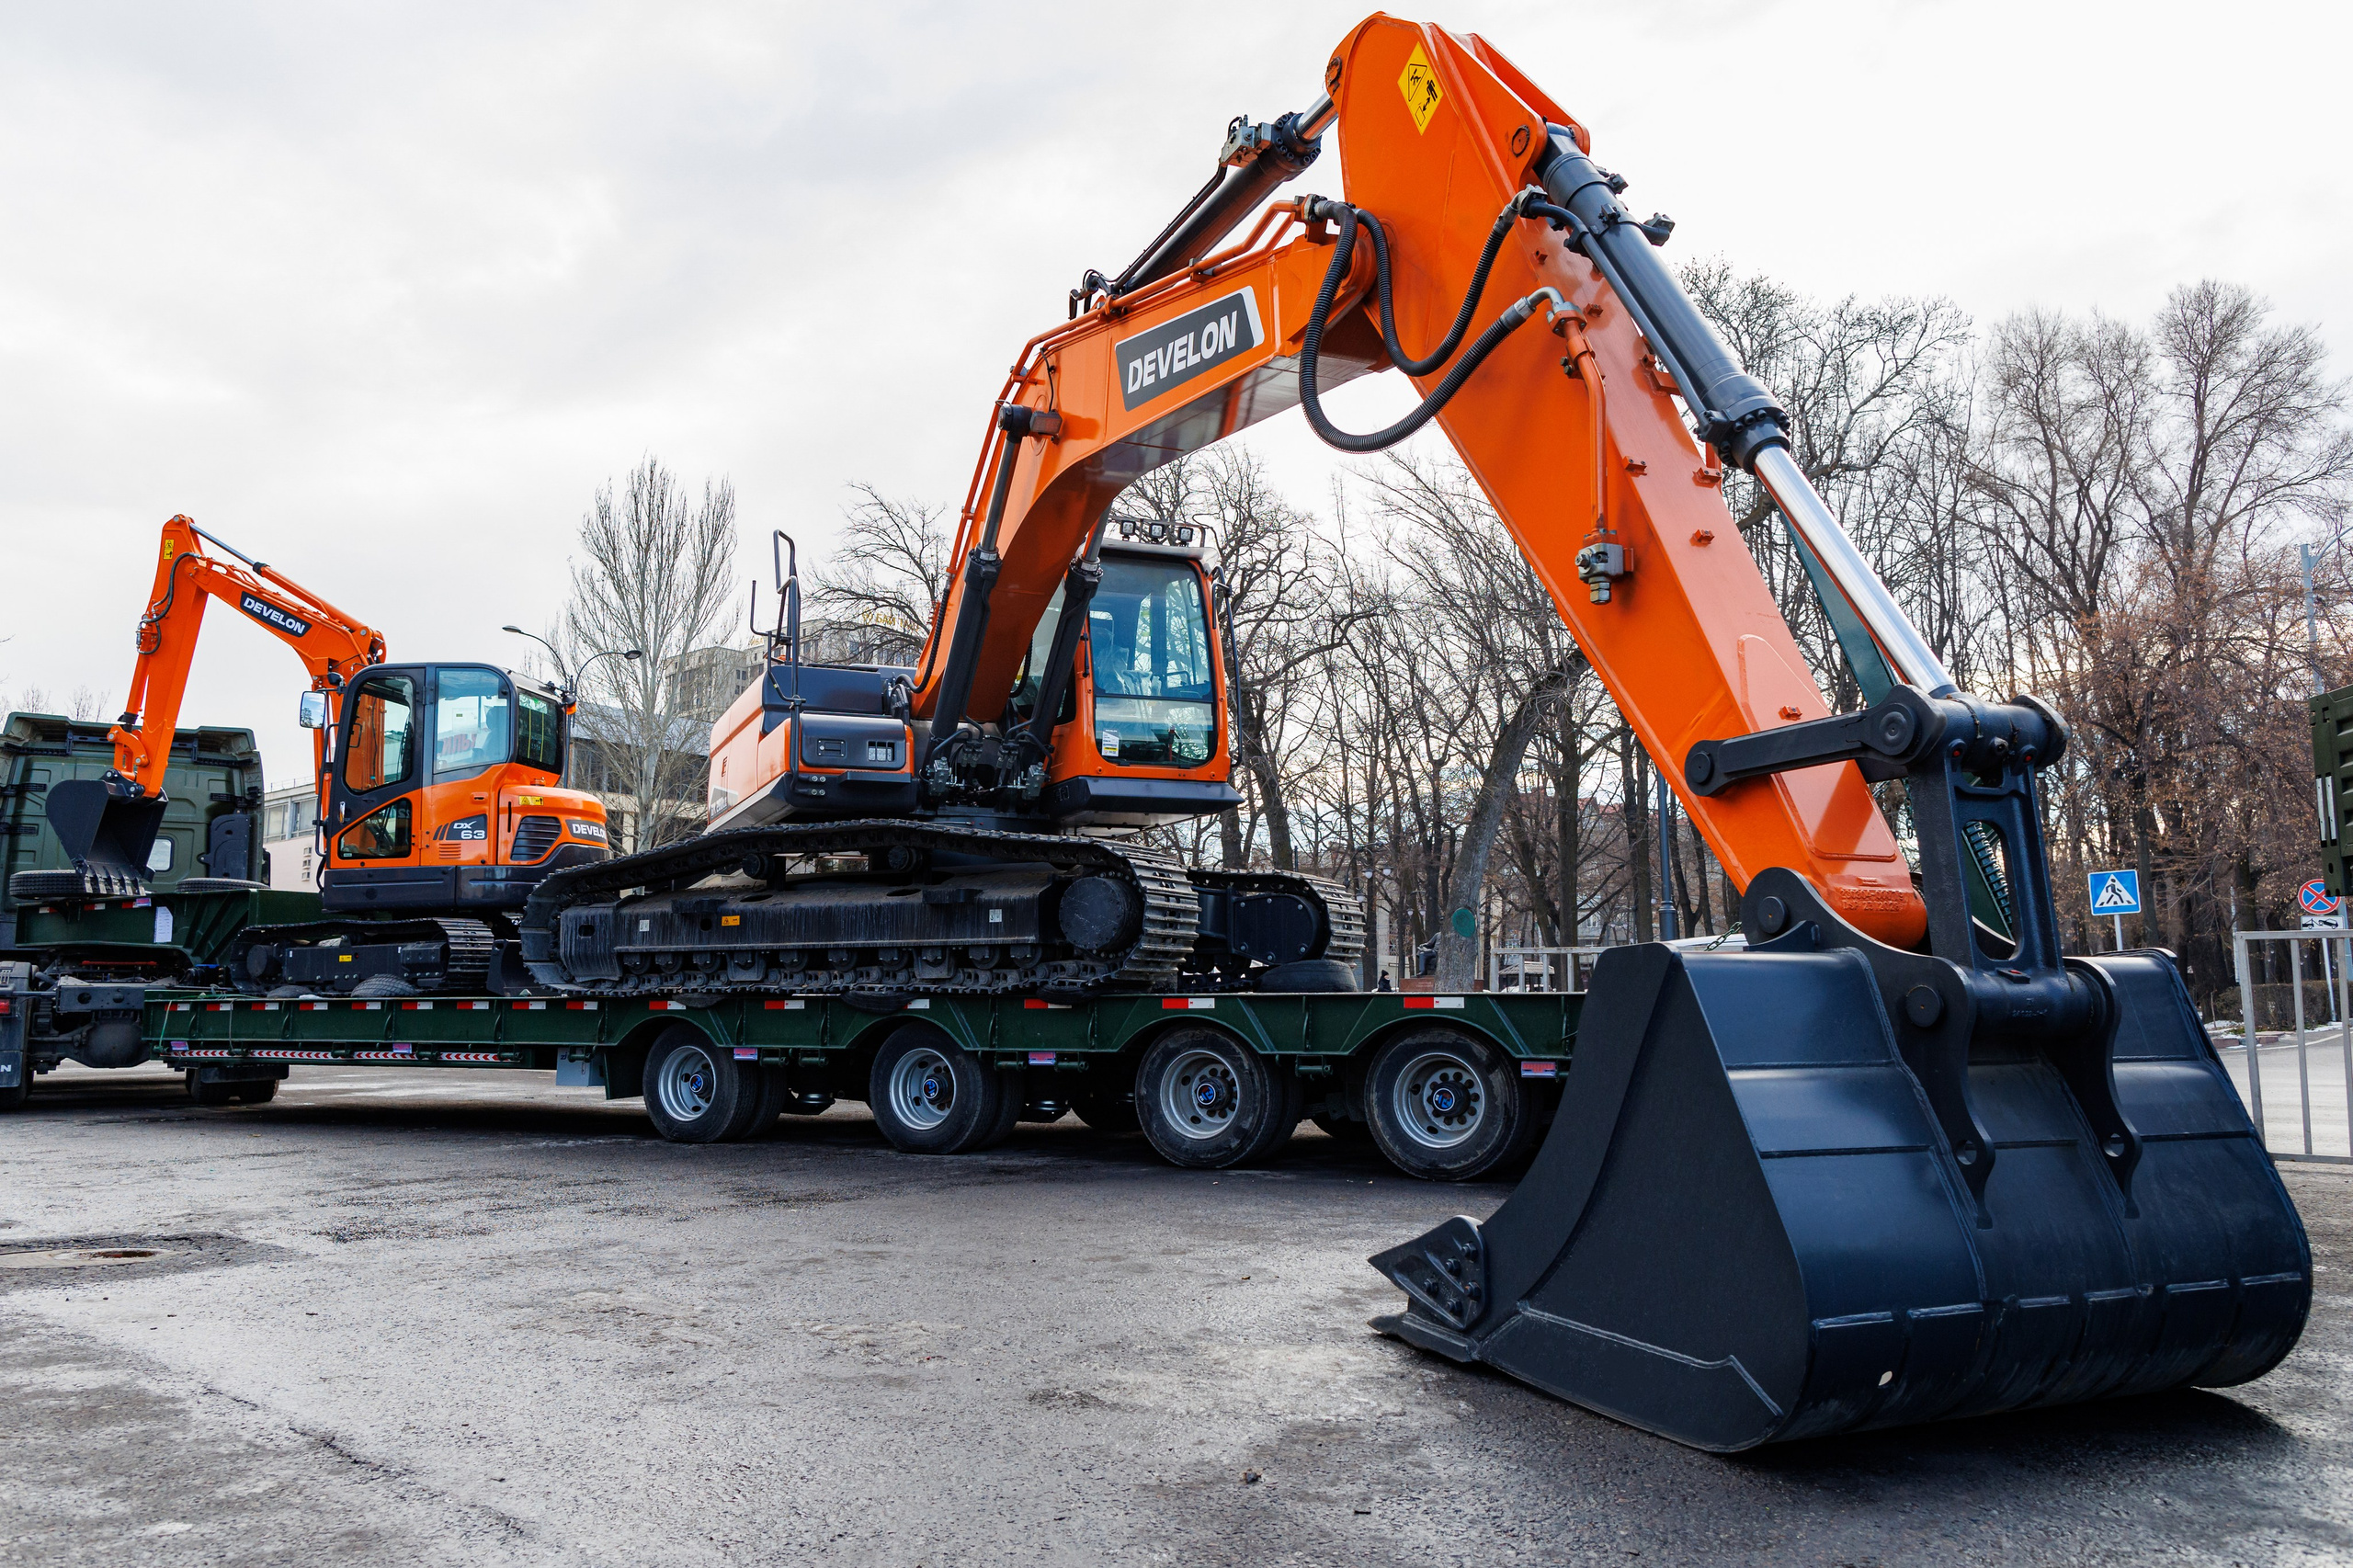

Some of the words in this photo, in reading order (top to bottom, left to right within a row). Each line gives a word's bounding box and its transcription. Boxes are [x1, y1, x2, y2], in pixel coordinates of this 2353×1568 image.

[1128, 311, 1237, 394] DEVELON
[243, 597, 306, 634] DEVELON
[453, 820, 477, 829] DX
[572, 824, 607, 839] DEVELO
[460, 829, 485, 839] 63
